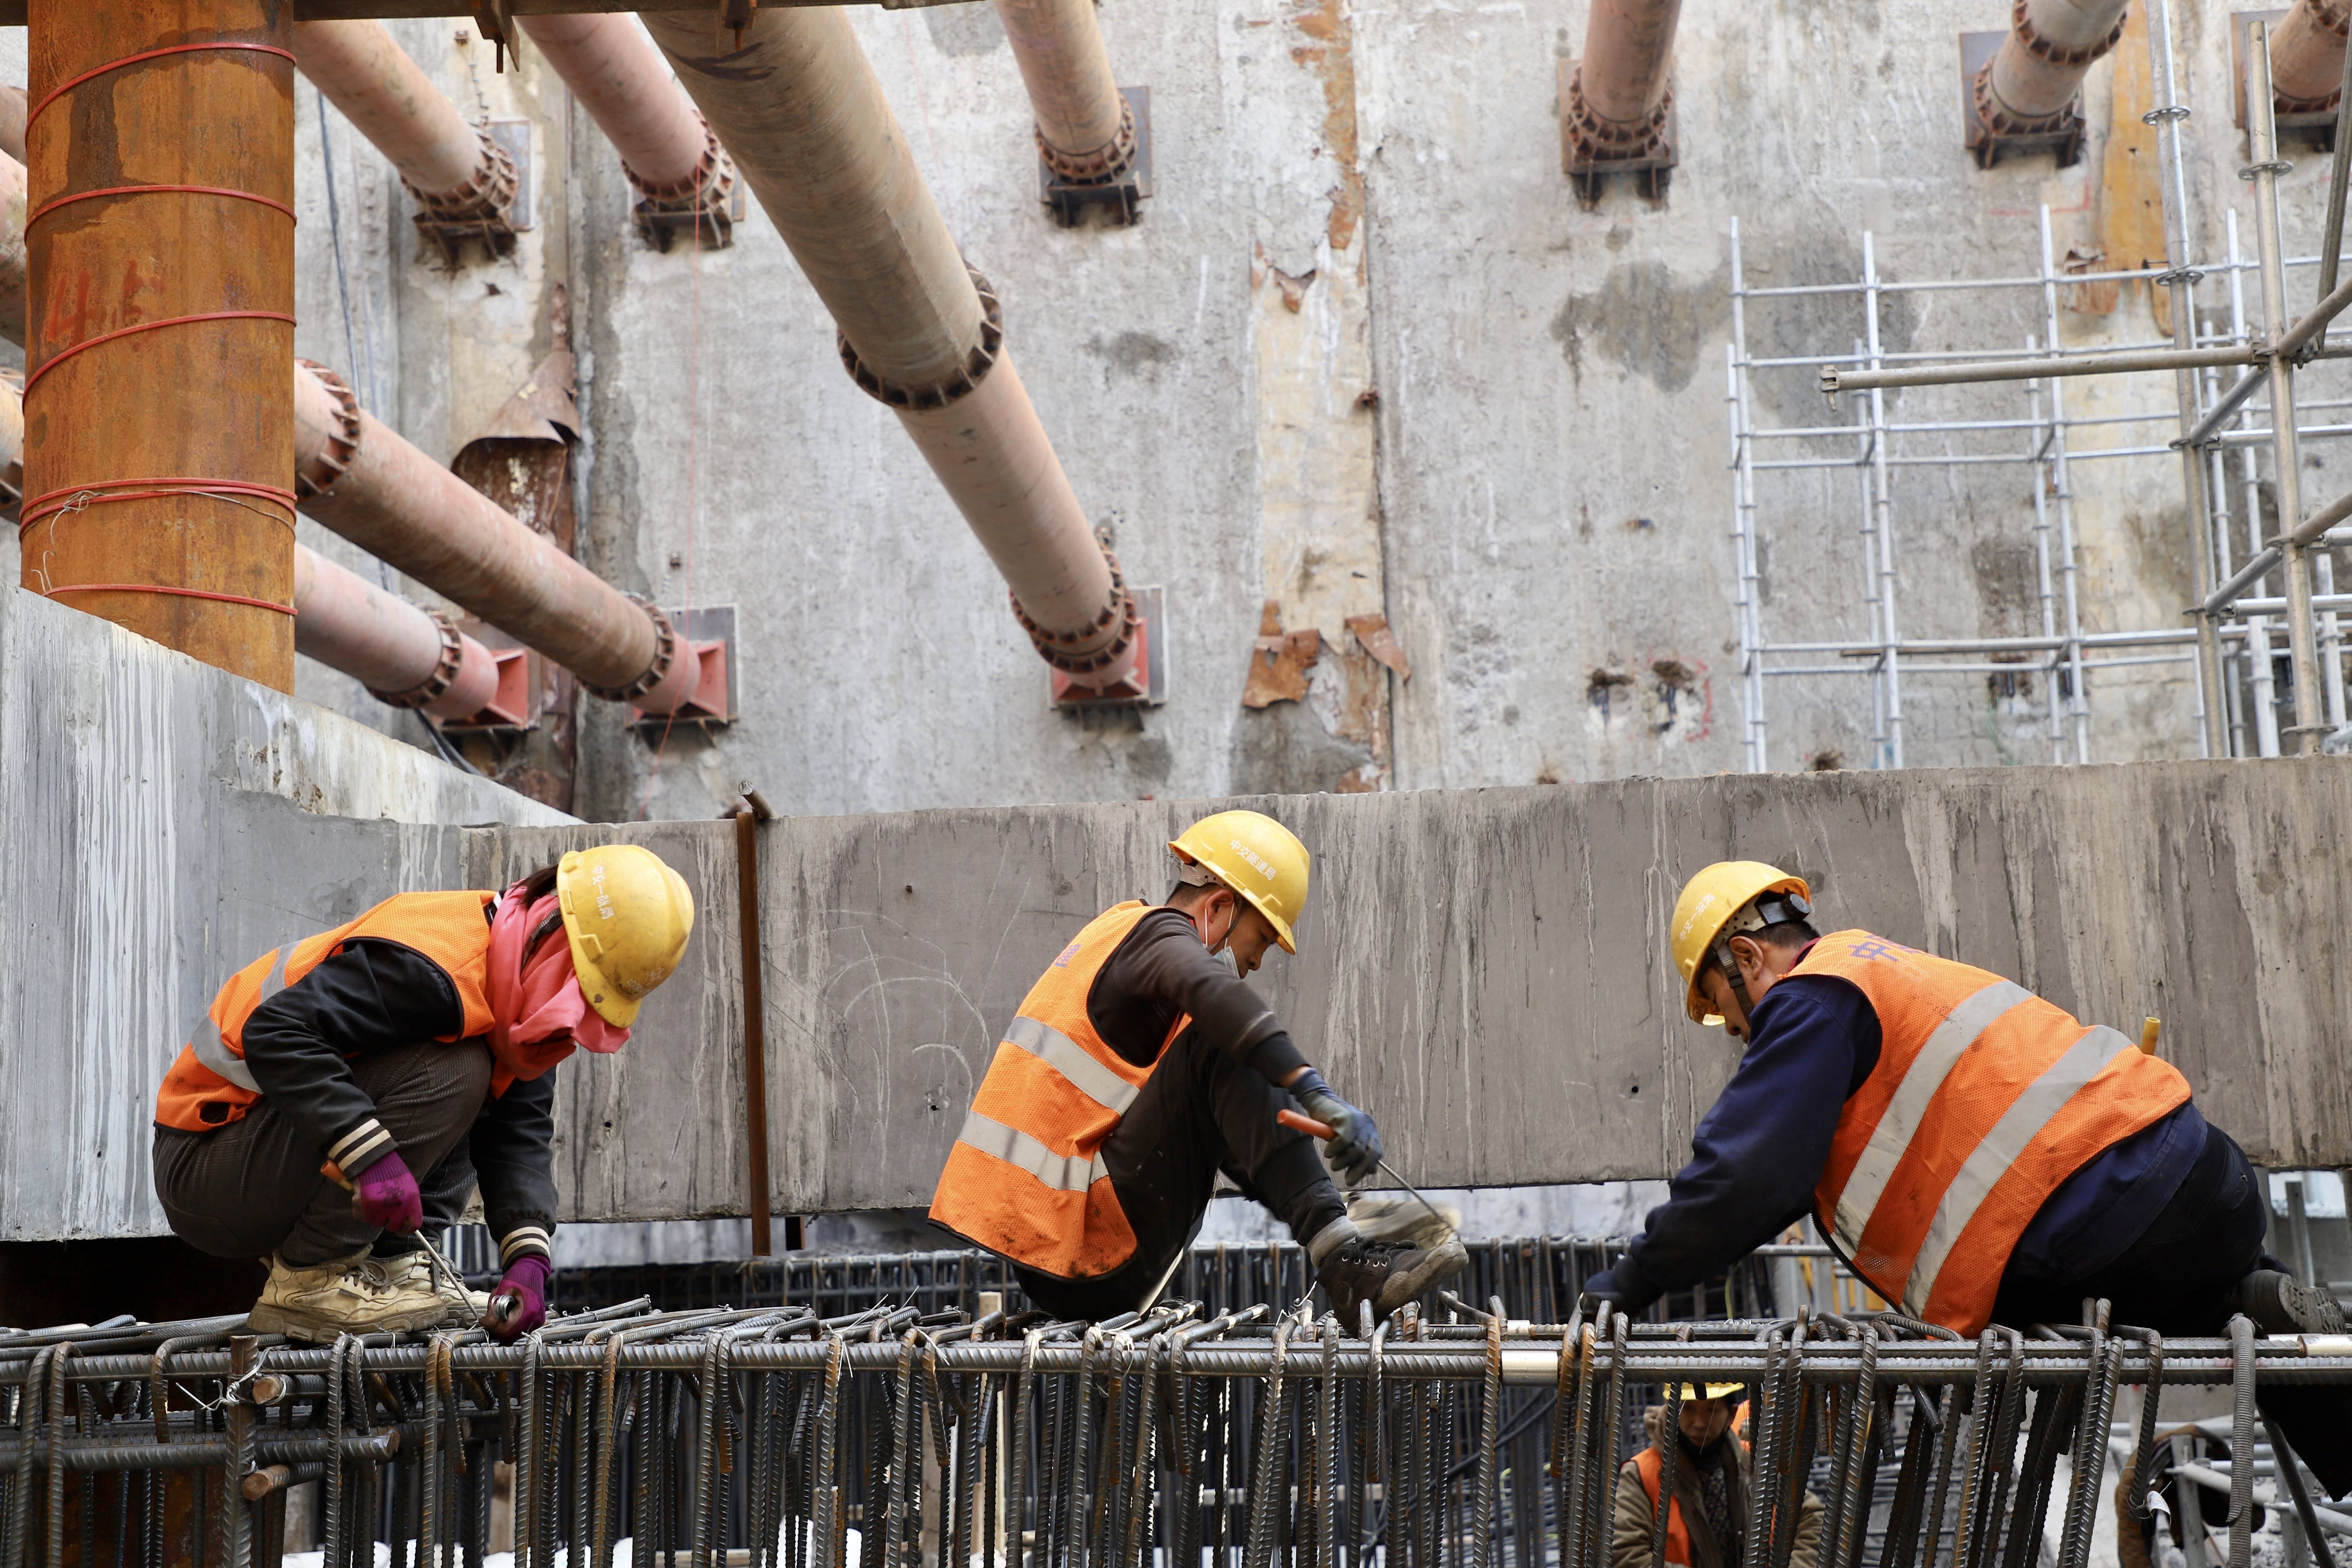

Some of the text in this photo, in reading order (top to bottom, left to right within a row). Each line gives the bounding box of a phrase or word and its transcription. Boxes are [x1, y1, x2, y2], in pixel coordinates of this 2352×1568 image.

[1230, 840, 1277, 881] 中交隧道局
[591, 865, 614, 920] 中交一航局
[1680, 893, 1715, 940] 中交一航局
